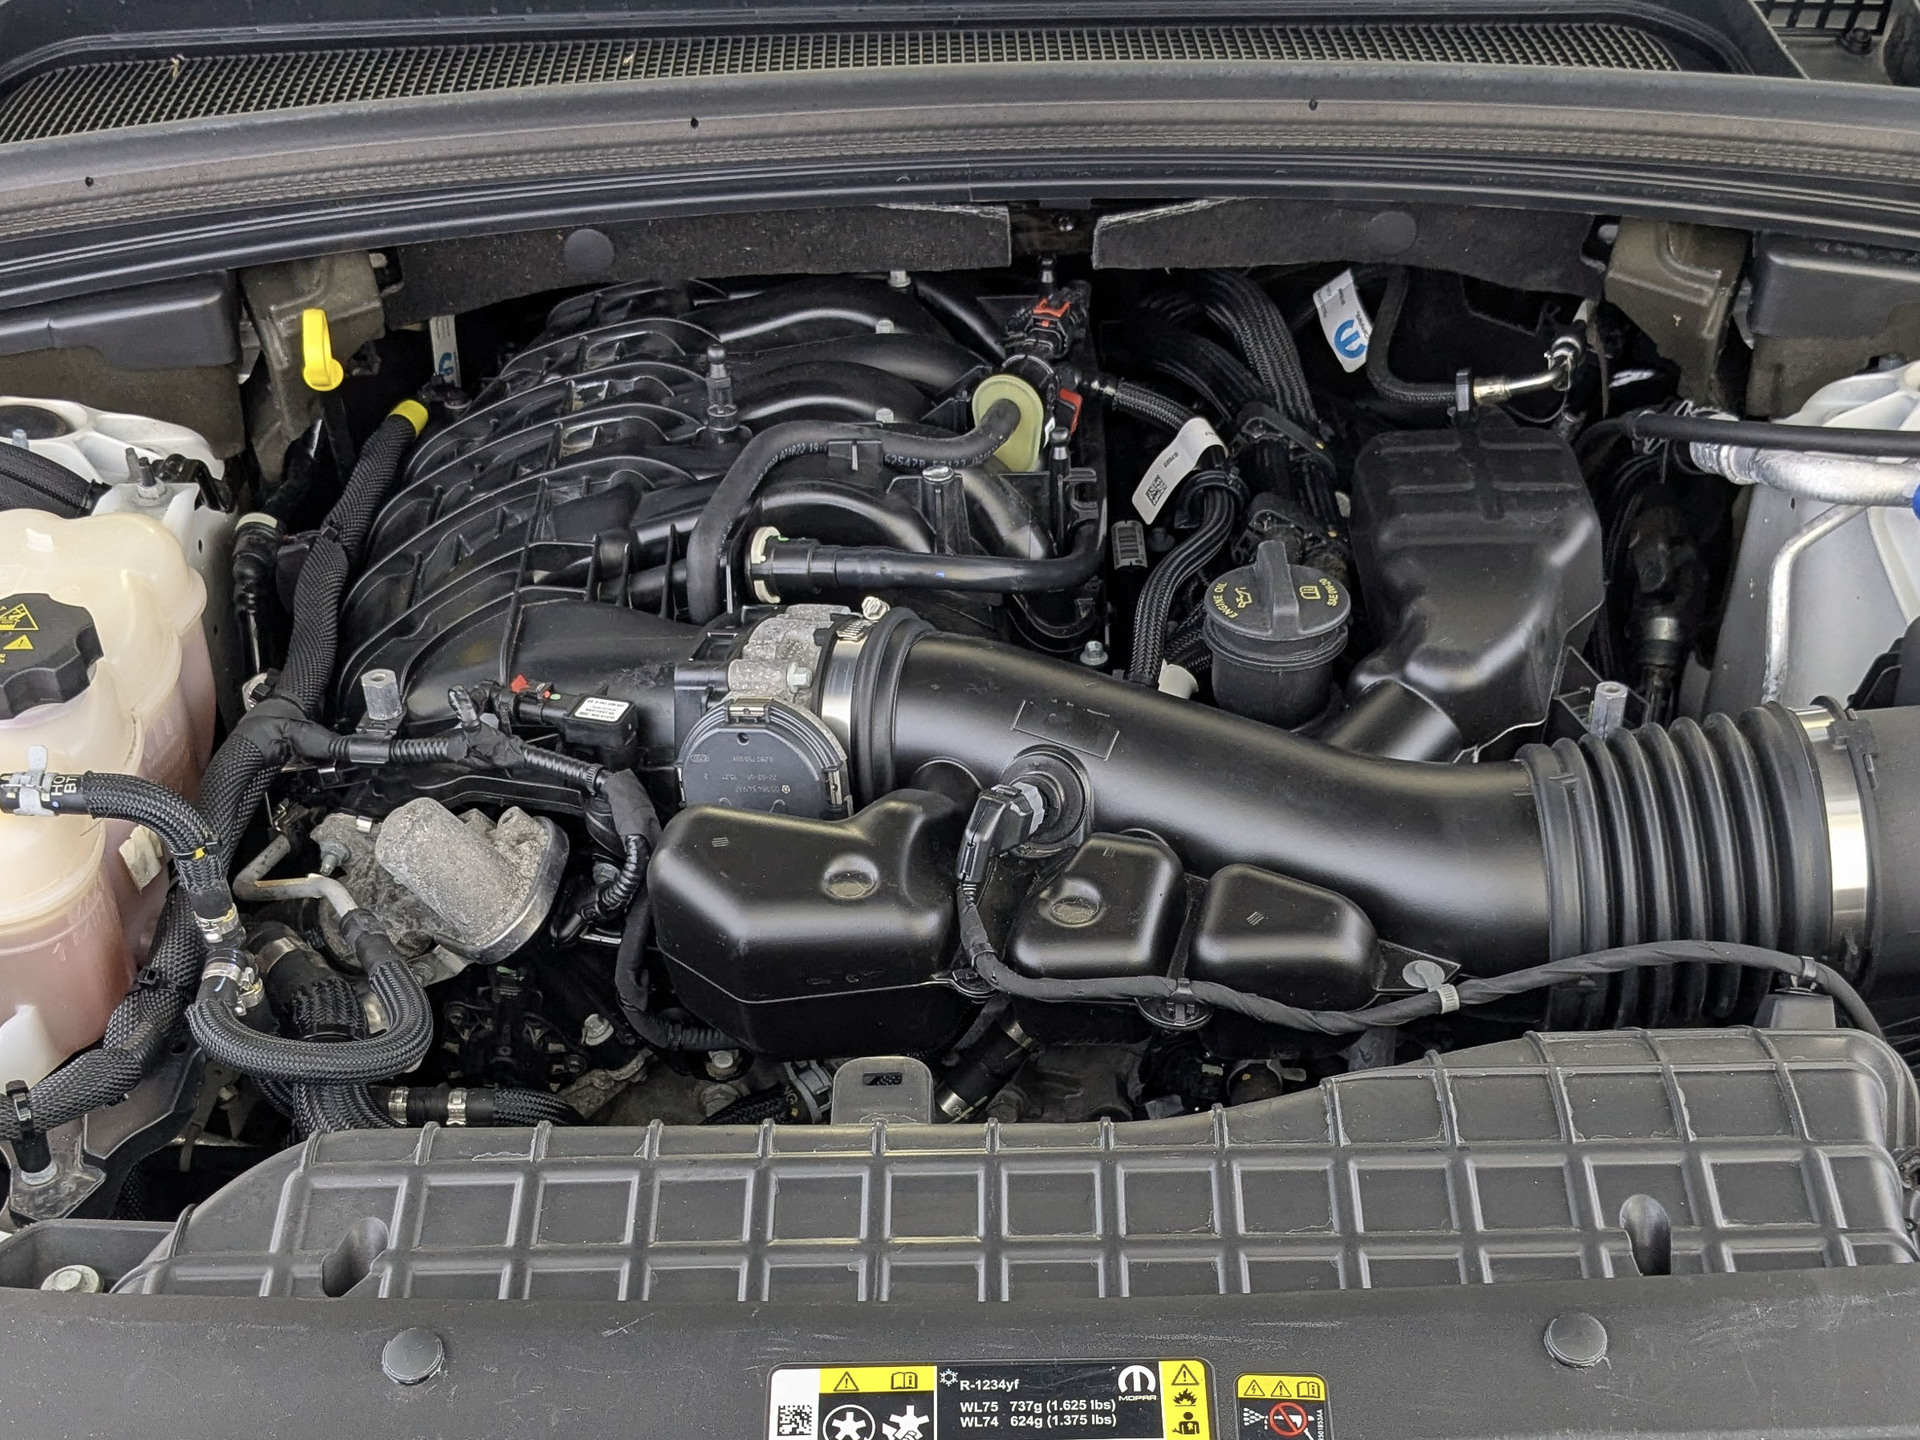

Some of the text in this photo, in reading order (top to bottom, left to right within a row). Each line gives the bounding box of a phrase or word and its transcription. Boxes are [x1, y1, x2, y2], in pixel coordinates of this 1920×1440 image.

[1213, 582, 1239, 619] ENGINE OIL
[959, 1379, 1020, 1392] R-1234yf
[960, 1398, 1117, 1414] WL75 737g (1.625 lbs)
[1118, 1394, 1157, 1402] MOPAR
[960, 1413, 1118, 1429] WL74 624g (1.375 lbs)
